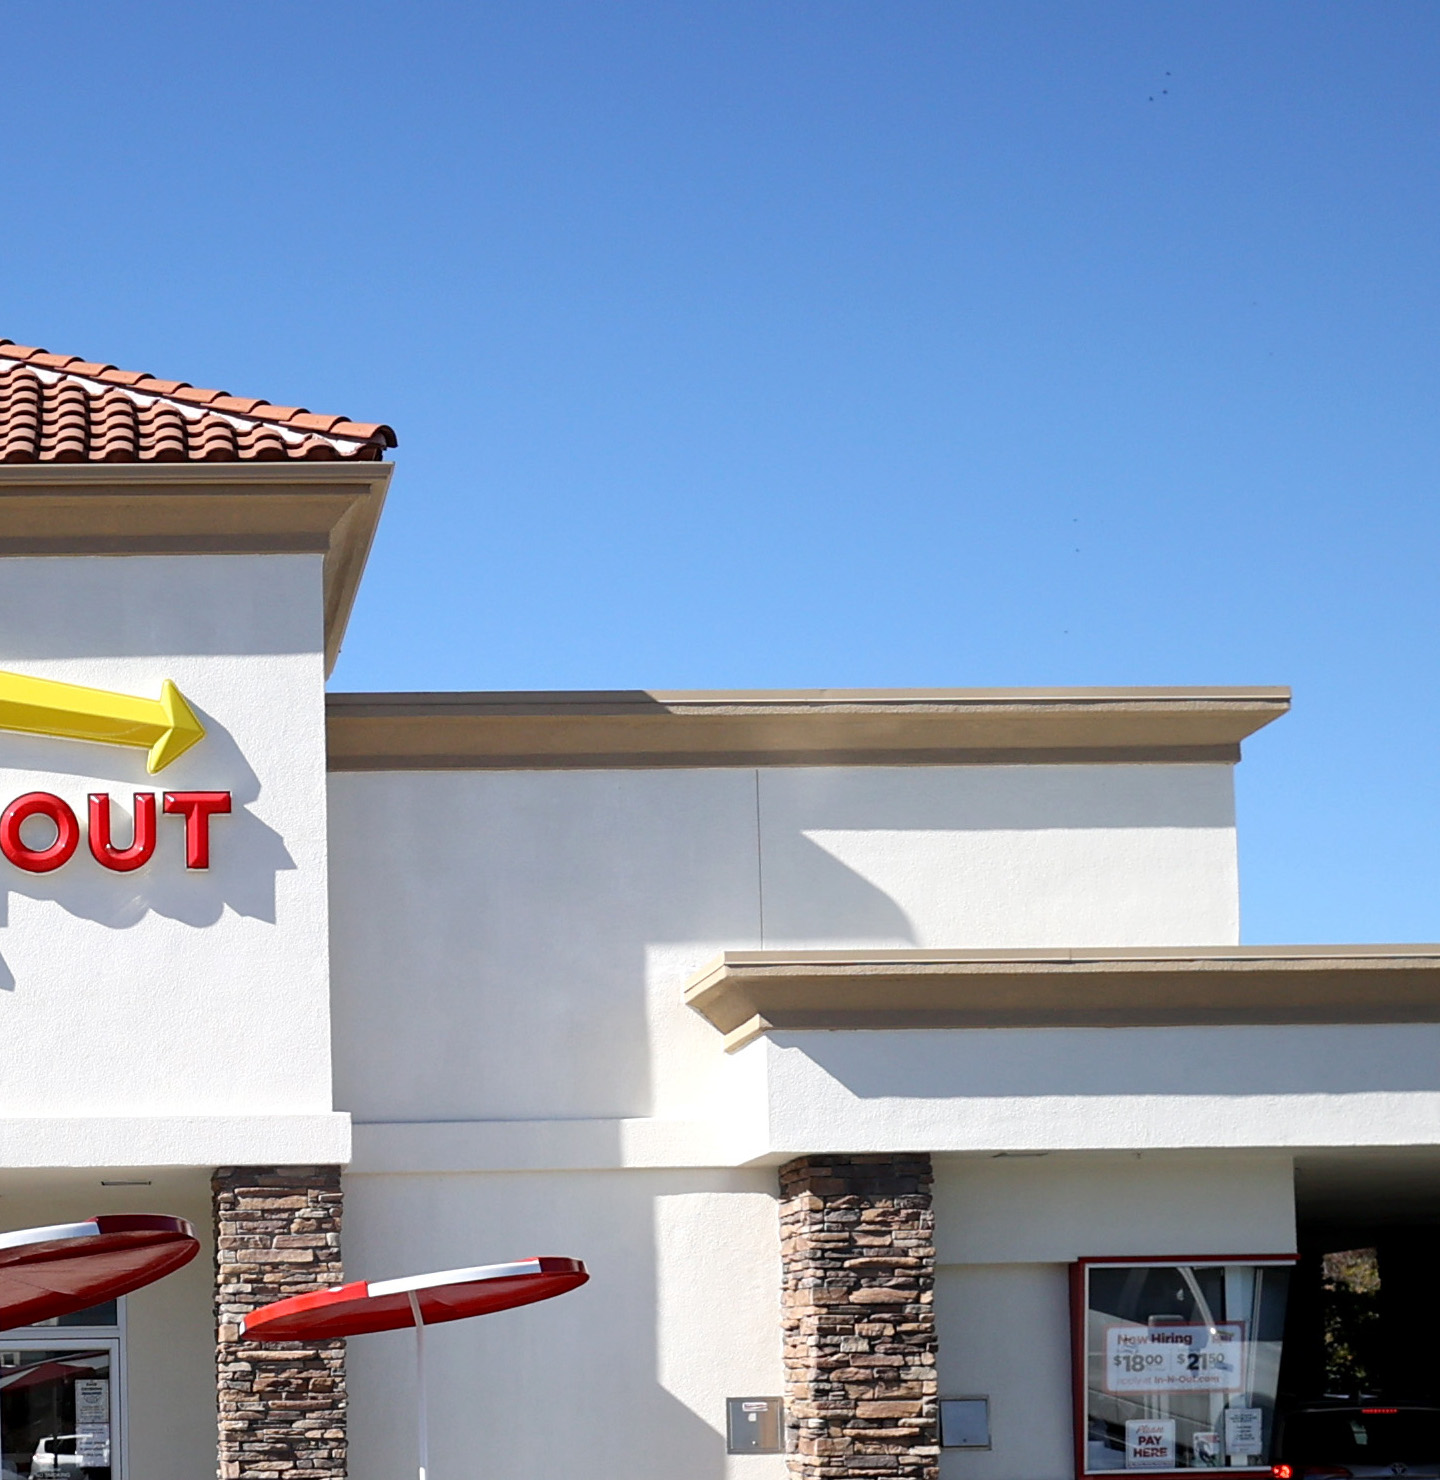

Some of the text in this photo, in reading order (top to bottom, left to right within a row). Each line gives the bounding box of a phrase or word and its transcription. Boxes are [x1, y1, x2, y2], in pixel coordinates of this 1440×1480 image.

[1151, 1332, 1193, 1346] Hiring
[1138, 1435, 1162, 1446] PAY
[1133, 1447, 1168, 1458] HERE
